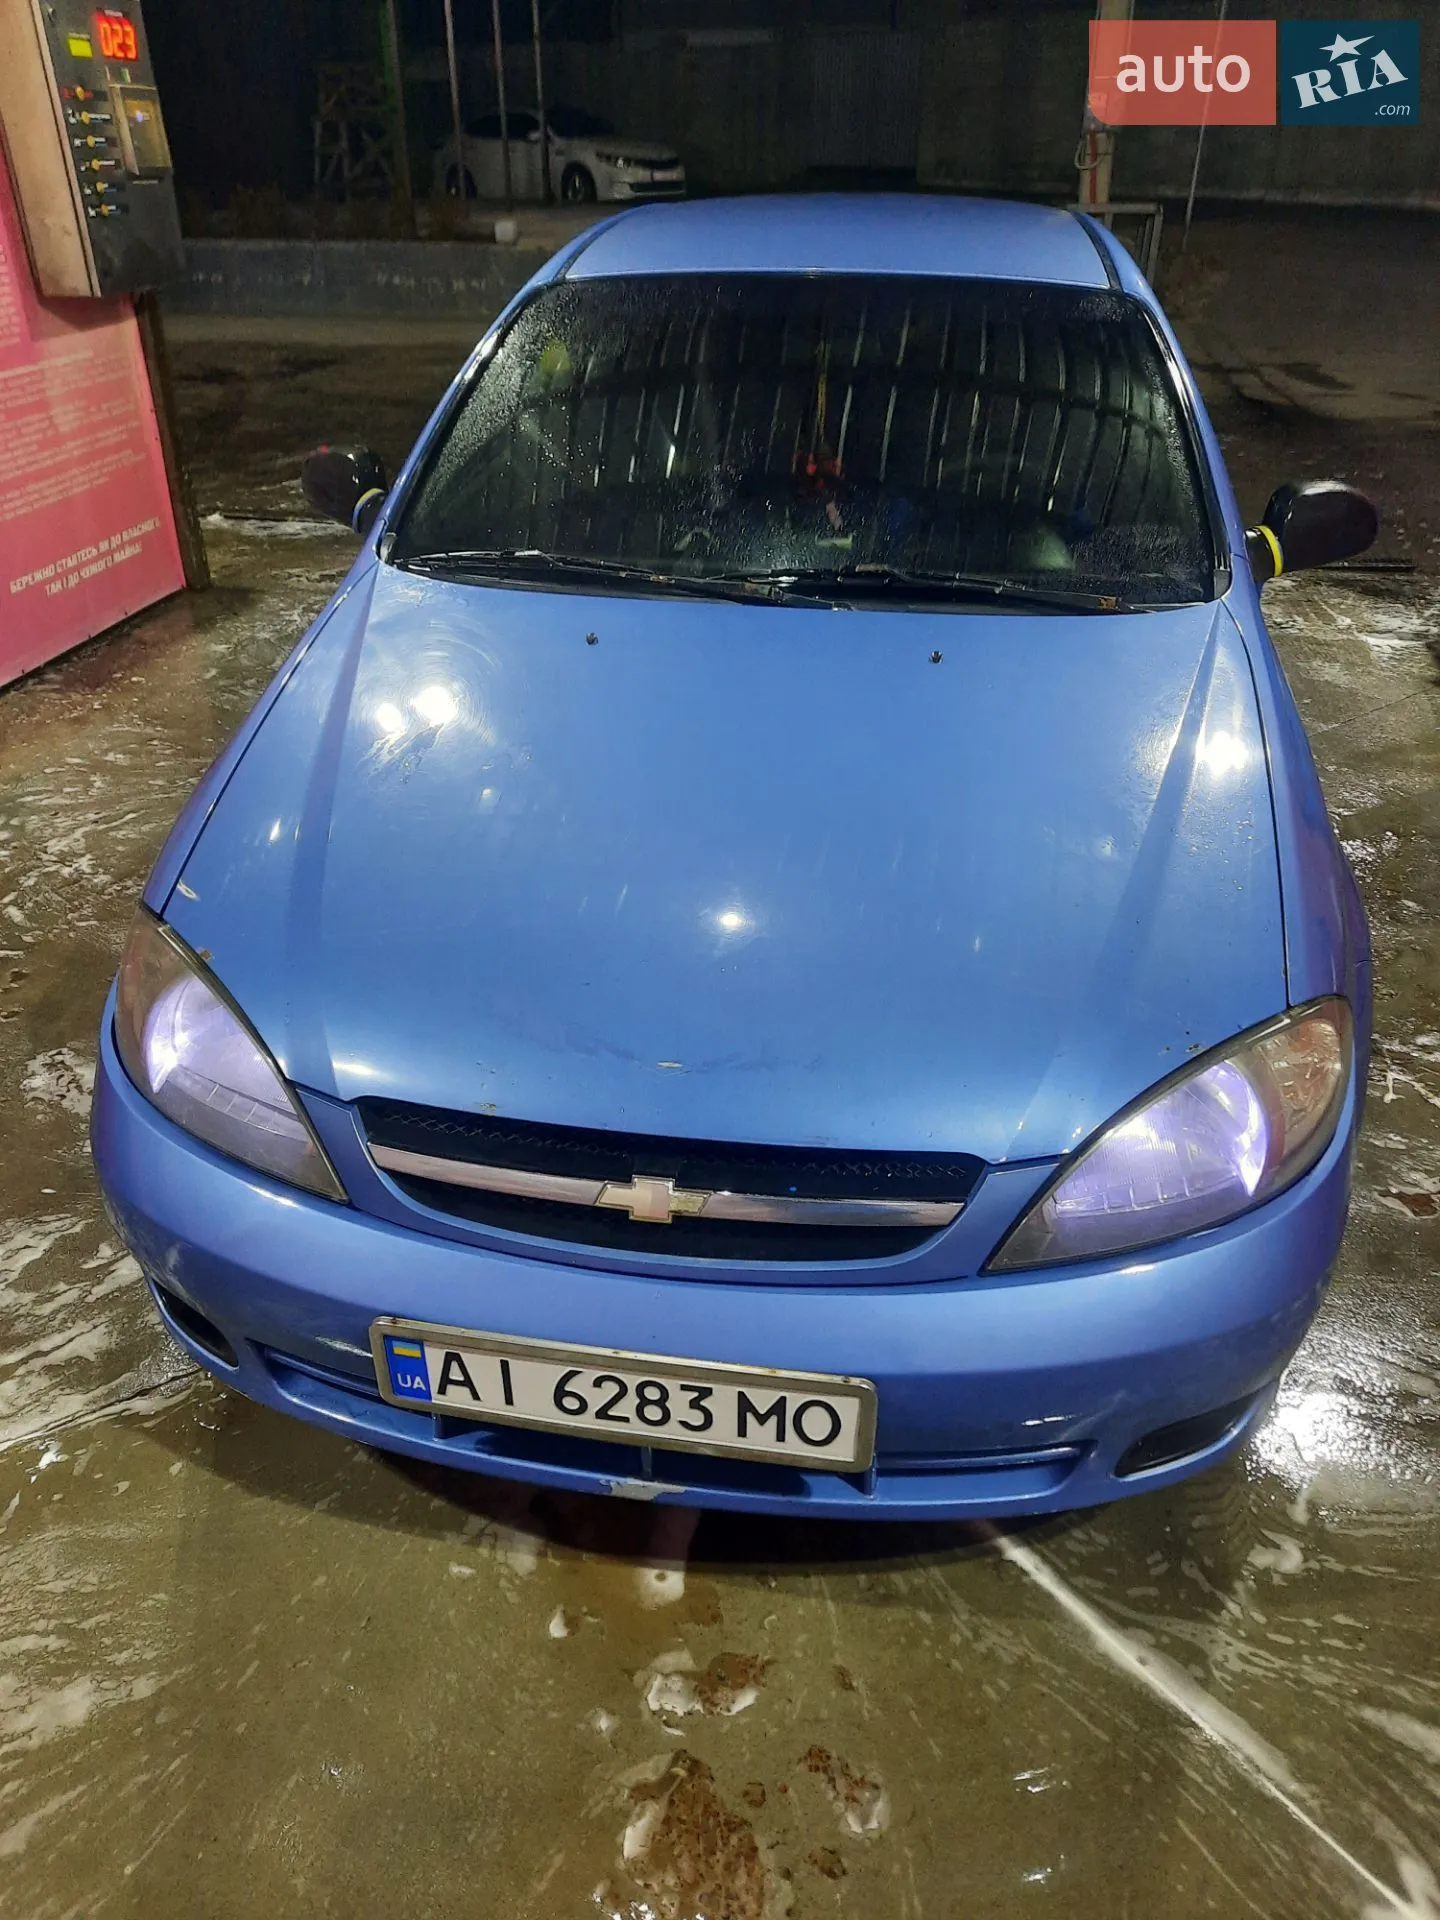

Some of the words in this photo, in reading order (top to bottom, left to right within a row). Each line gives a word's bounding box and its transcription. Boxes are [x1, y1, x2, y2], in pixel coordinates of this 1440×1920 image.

[9, 563, 55, 594] БЕРЕЖНО
[110, 533, 121, 549] ДО
[67, 573, 80, 589] ДО
[396, 1373, 427, 1392] UA
[553, 1369, 713, 1432] 6283
[737, 1390, 842, 1447] MO
